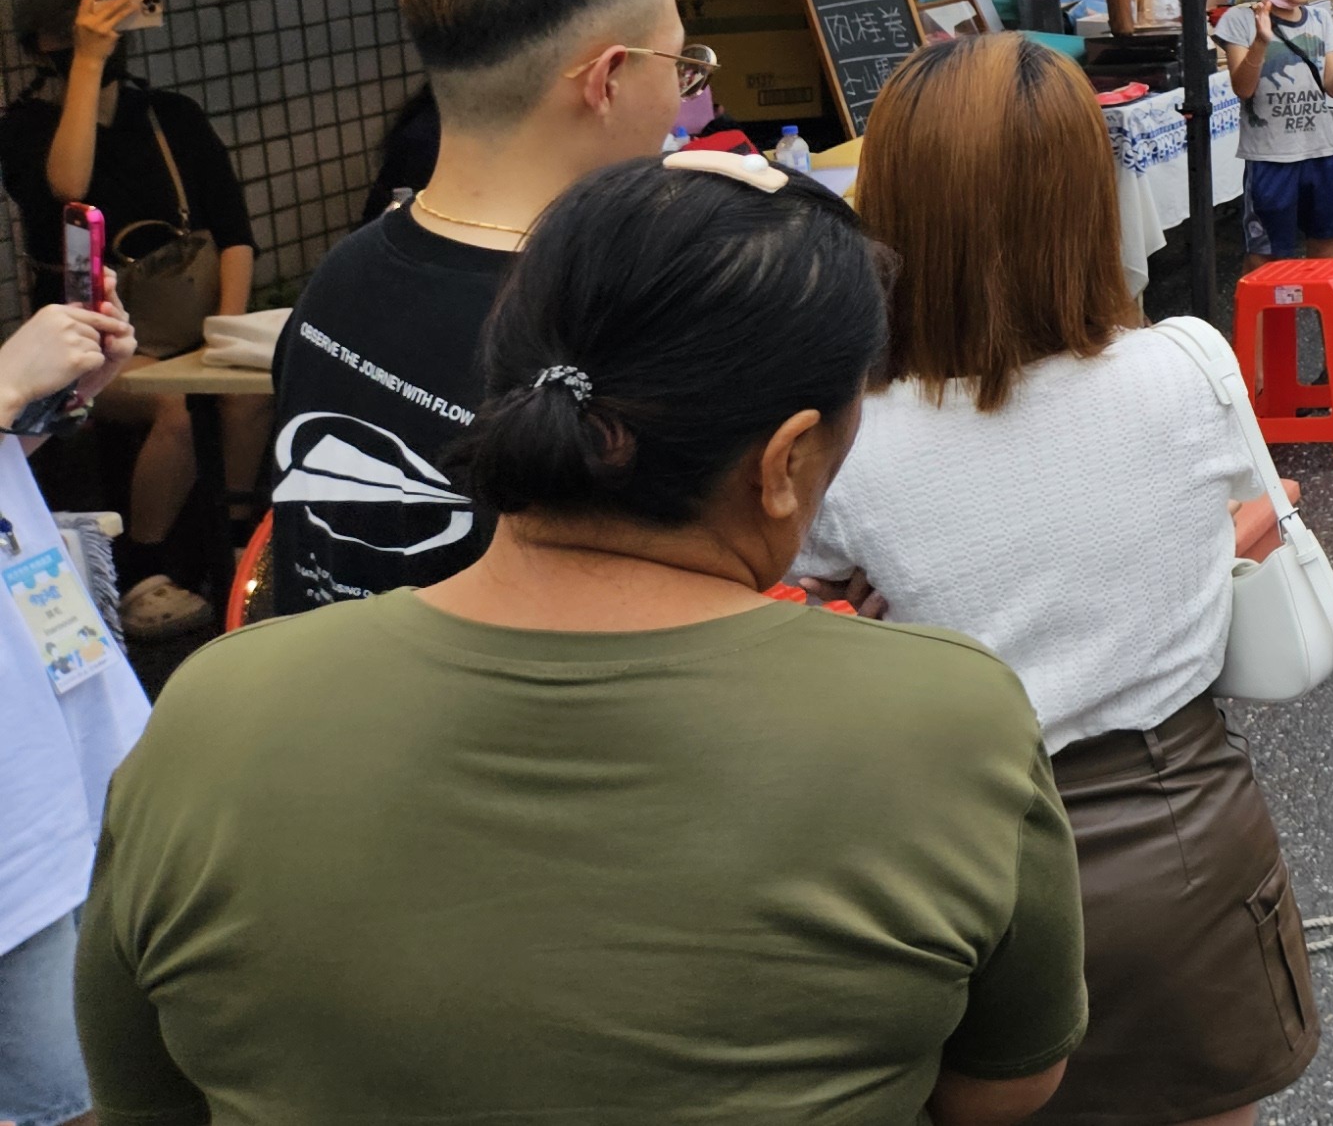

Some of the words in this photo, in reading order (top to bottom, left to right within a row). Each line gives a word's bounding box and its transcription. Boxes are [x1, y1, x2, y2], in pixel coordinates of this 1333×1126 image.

[1265, 90, 1326, 105] TYRANN
[1271, 101, 1328, 118] SAURUS
[1285, 115, 1316, 130] REX
[300, 321, 341, 358] OBSERVE
[339, 346, 361, 370] THE
[359, 360, 404, 393] JOURNEY
[402, 381, 434, 409] WITH
[432, 396, 475, 426] FLOW
